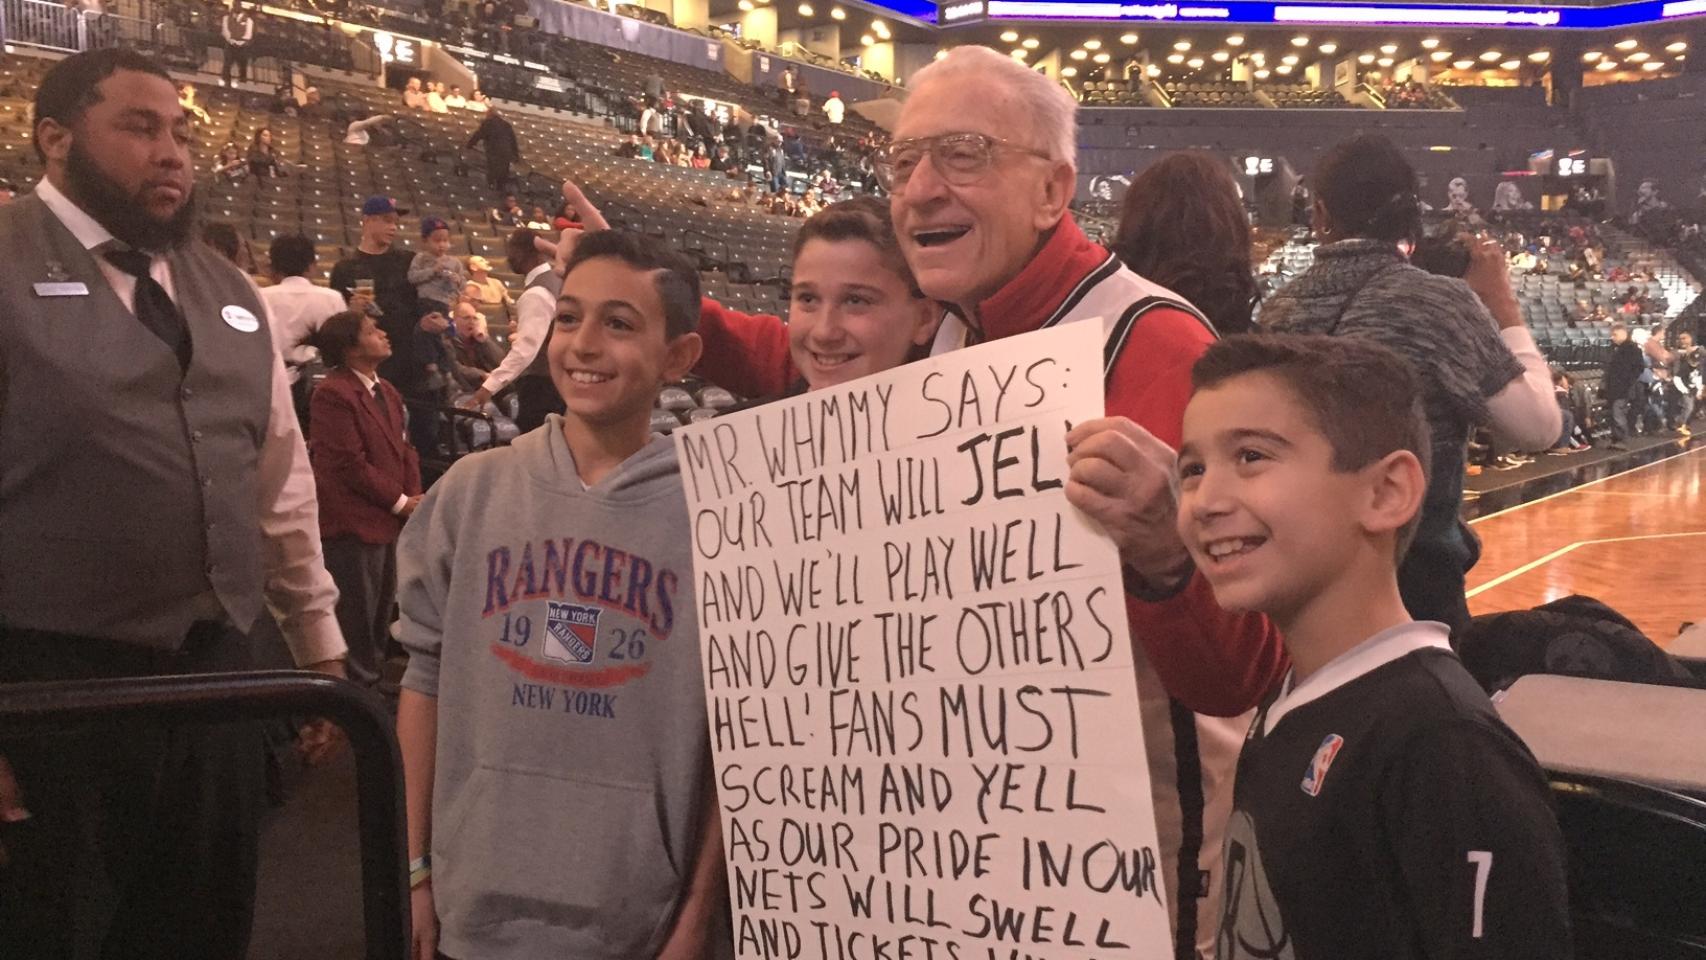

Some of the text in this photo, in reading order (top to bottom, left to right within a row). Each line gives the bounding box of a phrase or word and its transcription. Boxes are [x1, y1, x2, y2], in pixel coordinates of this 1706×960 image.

[682, 423, 753, 502] MR.
[916, 358, 1071, 439] SAYS:
[696, 420, 1073, 559] OUR TEAM WILL JEL
[482, 537, 678, 640] RANGERS
[703, 512, 1084, 628] AND WE'LL PLAY WELL
[499, 613, 646, 660] 19 26
[549, 607, 595, 624] NEW YORK
[554, 622, 591, 660] RANGERS
[709, 586, 1113, 689] AND GIVE THE OTHERS
[511, 682, 618, 719] NEW YORK
[829, 688, 923, 757] FANS
[940, 684, 1112, 759] MUST
[721, 763, 1106, 824] SCREAM AND YELL
[729, 817, 1163, 907] AS OUR PRIDE IN OUR
[1467, 850, 1494, 938] 7
[735, 865, 1131, 949] NETS WILL SWELL
[738, 914, 801, 960] AND
